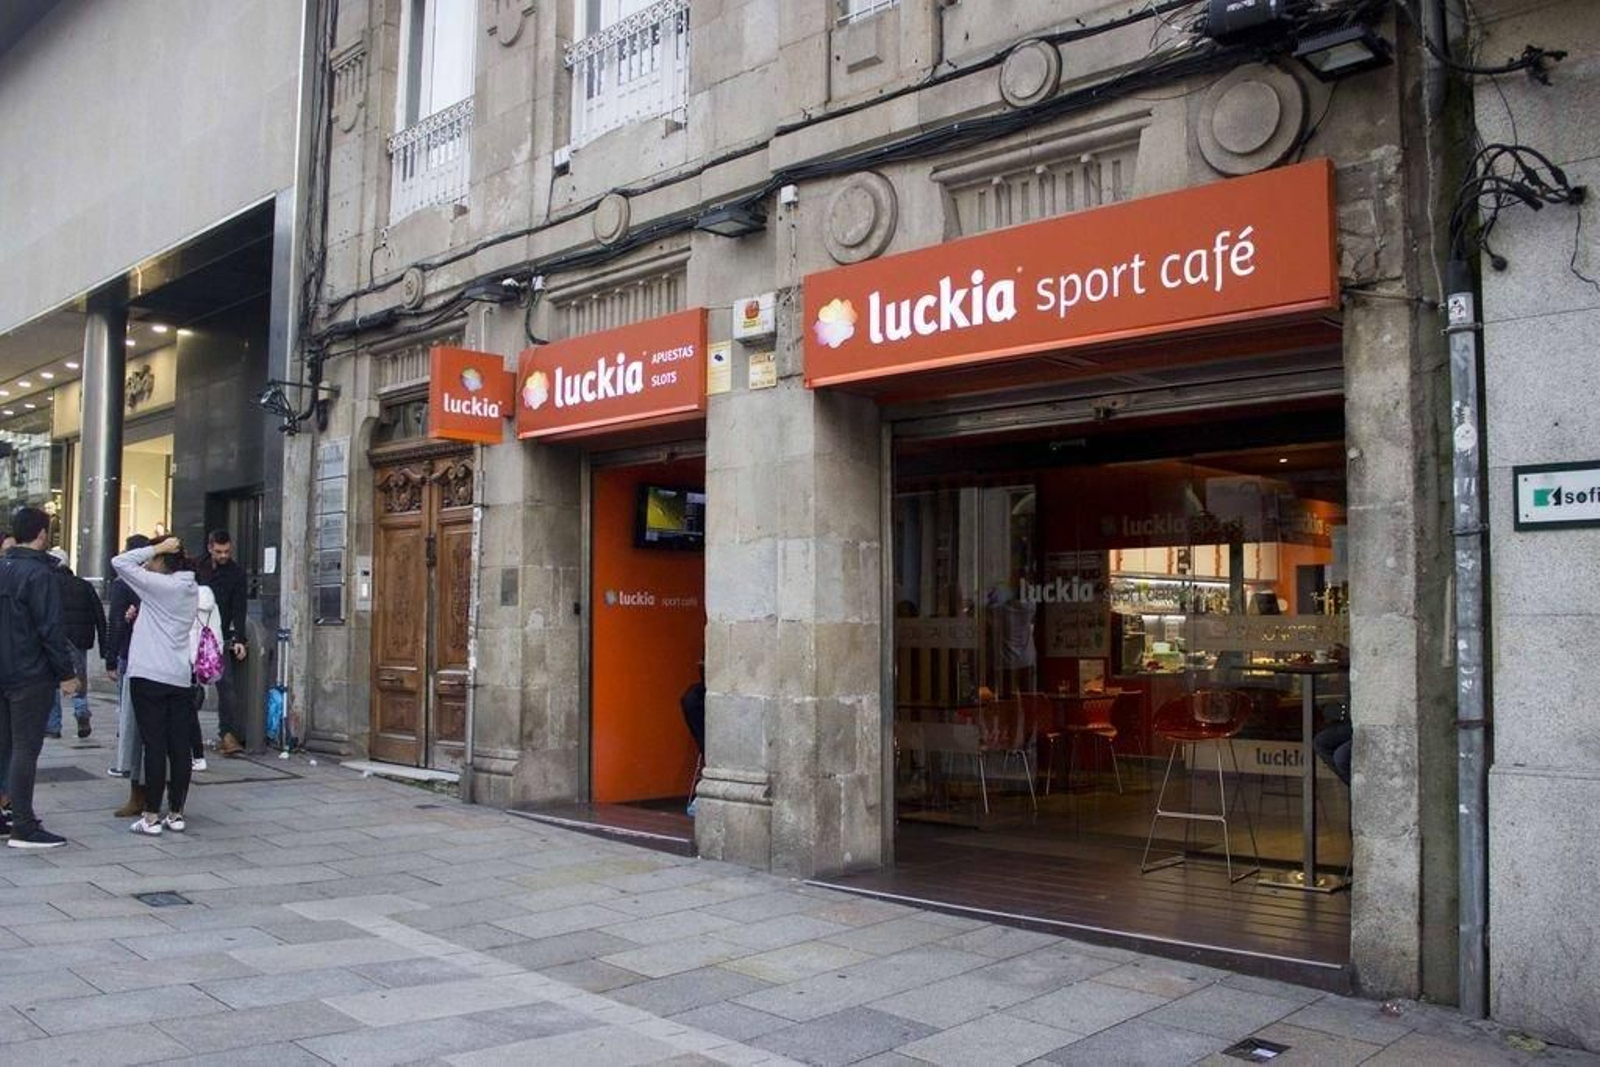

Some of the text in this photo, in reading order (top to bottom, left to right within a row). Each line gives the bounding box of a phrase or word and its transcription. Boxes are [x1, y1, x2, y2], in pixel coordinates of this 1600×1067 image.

[868, 225, 1256, 345] luckia sport café
[651, 344, 694, 364] APUESTAS
[554, 351, 644, 409] luckia
[651, 372, 677, 388] SLOTS
[443, 393, 500, 419] luckia
[619, 590, 655, 606] luckia
[1019, 576, 1095, 604] luckia
